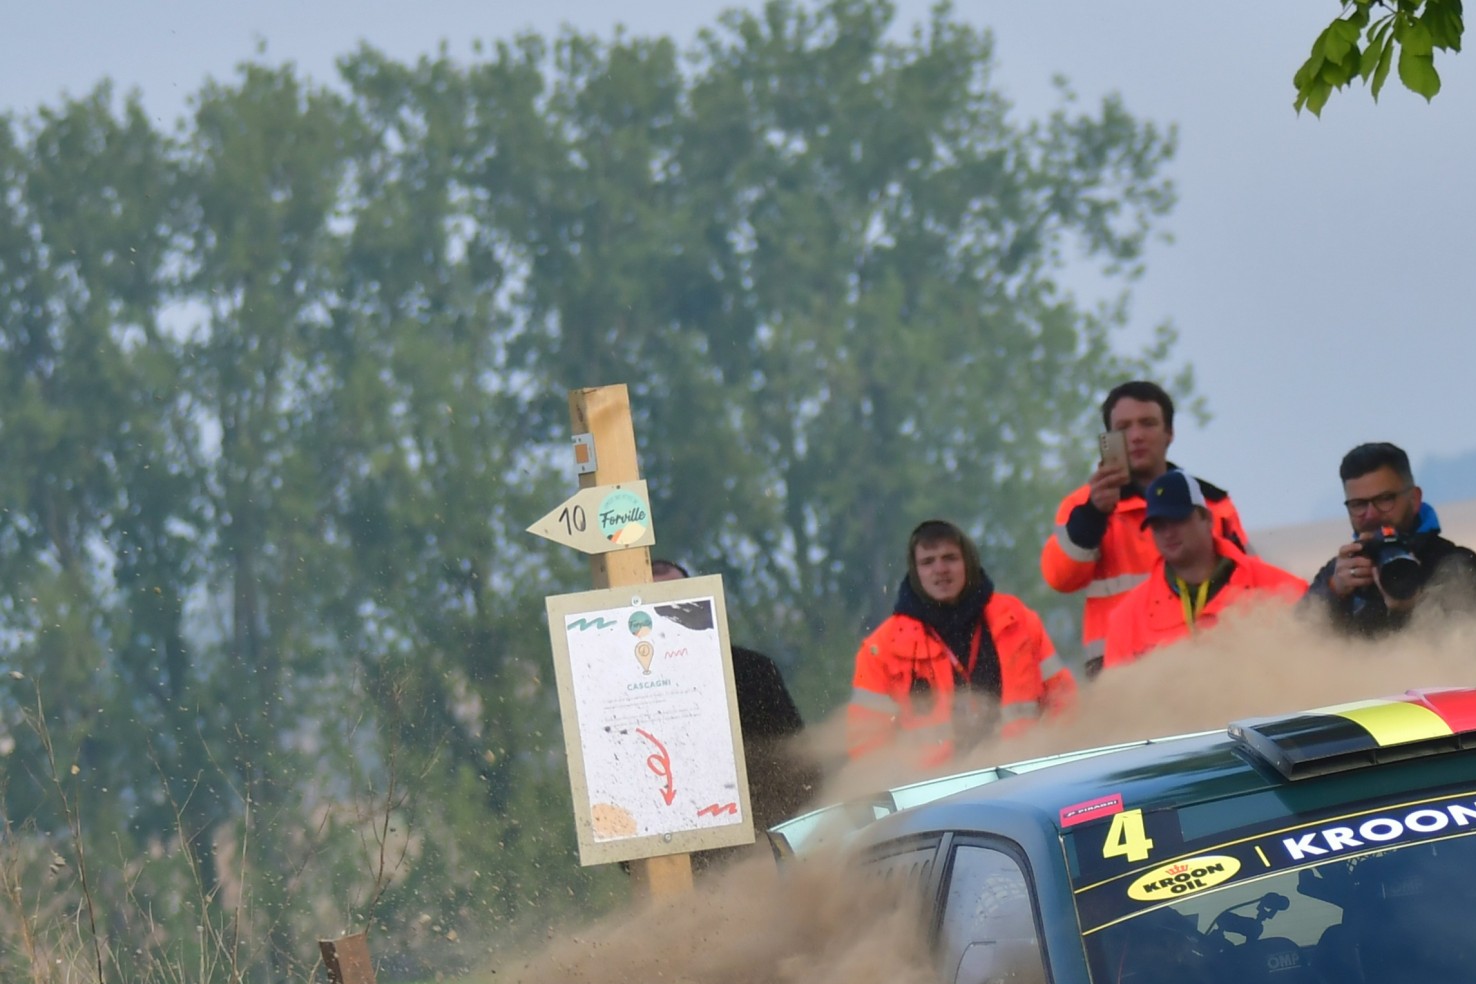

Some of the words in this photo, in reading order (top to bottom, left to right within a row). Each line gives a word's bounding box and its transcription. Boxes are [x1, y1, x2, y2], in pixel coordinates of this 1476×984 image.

[558, 504, 586, 536] 10
[599, 506, 646, 529] Forville
[1102, 808, 1153, 862] 4
[1142, 862, 1225, 894] KROON
[1170, 878, 1207, 894] OIL
